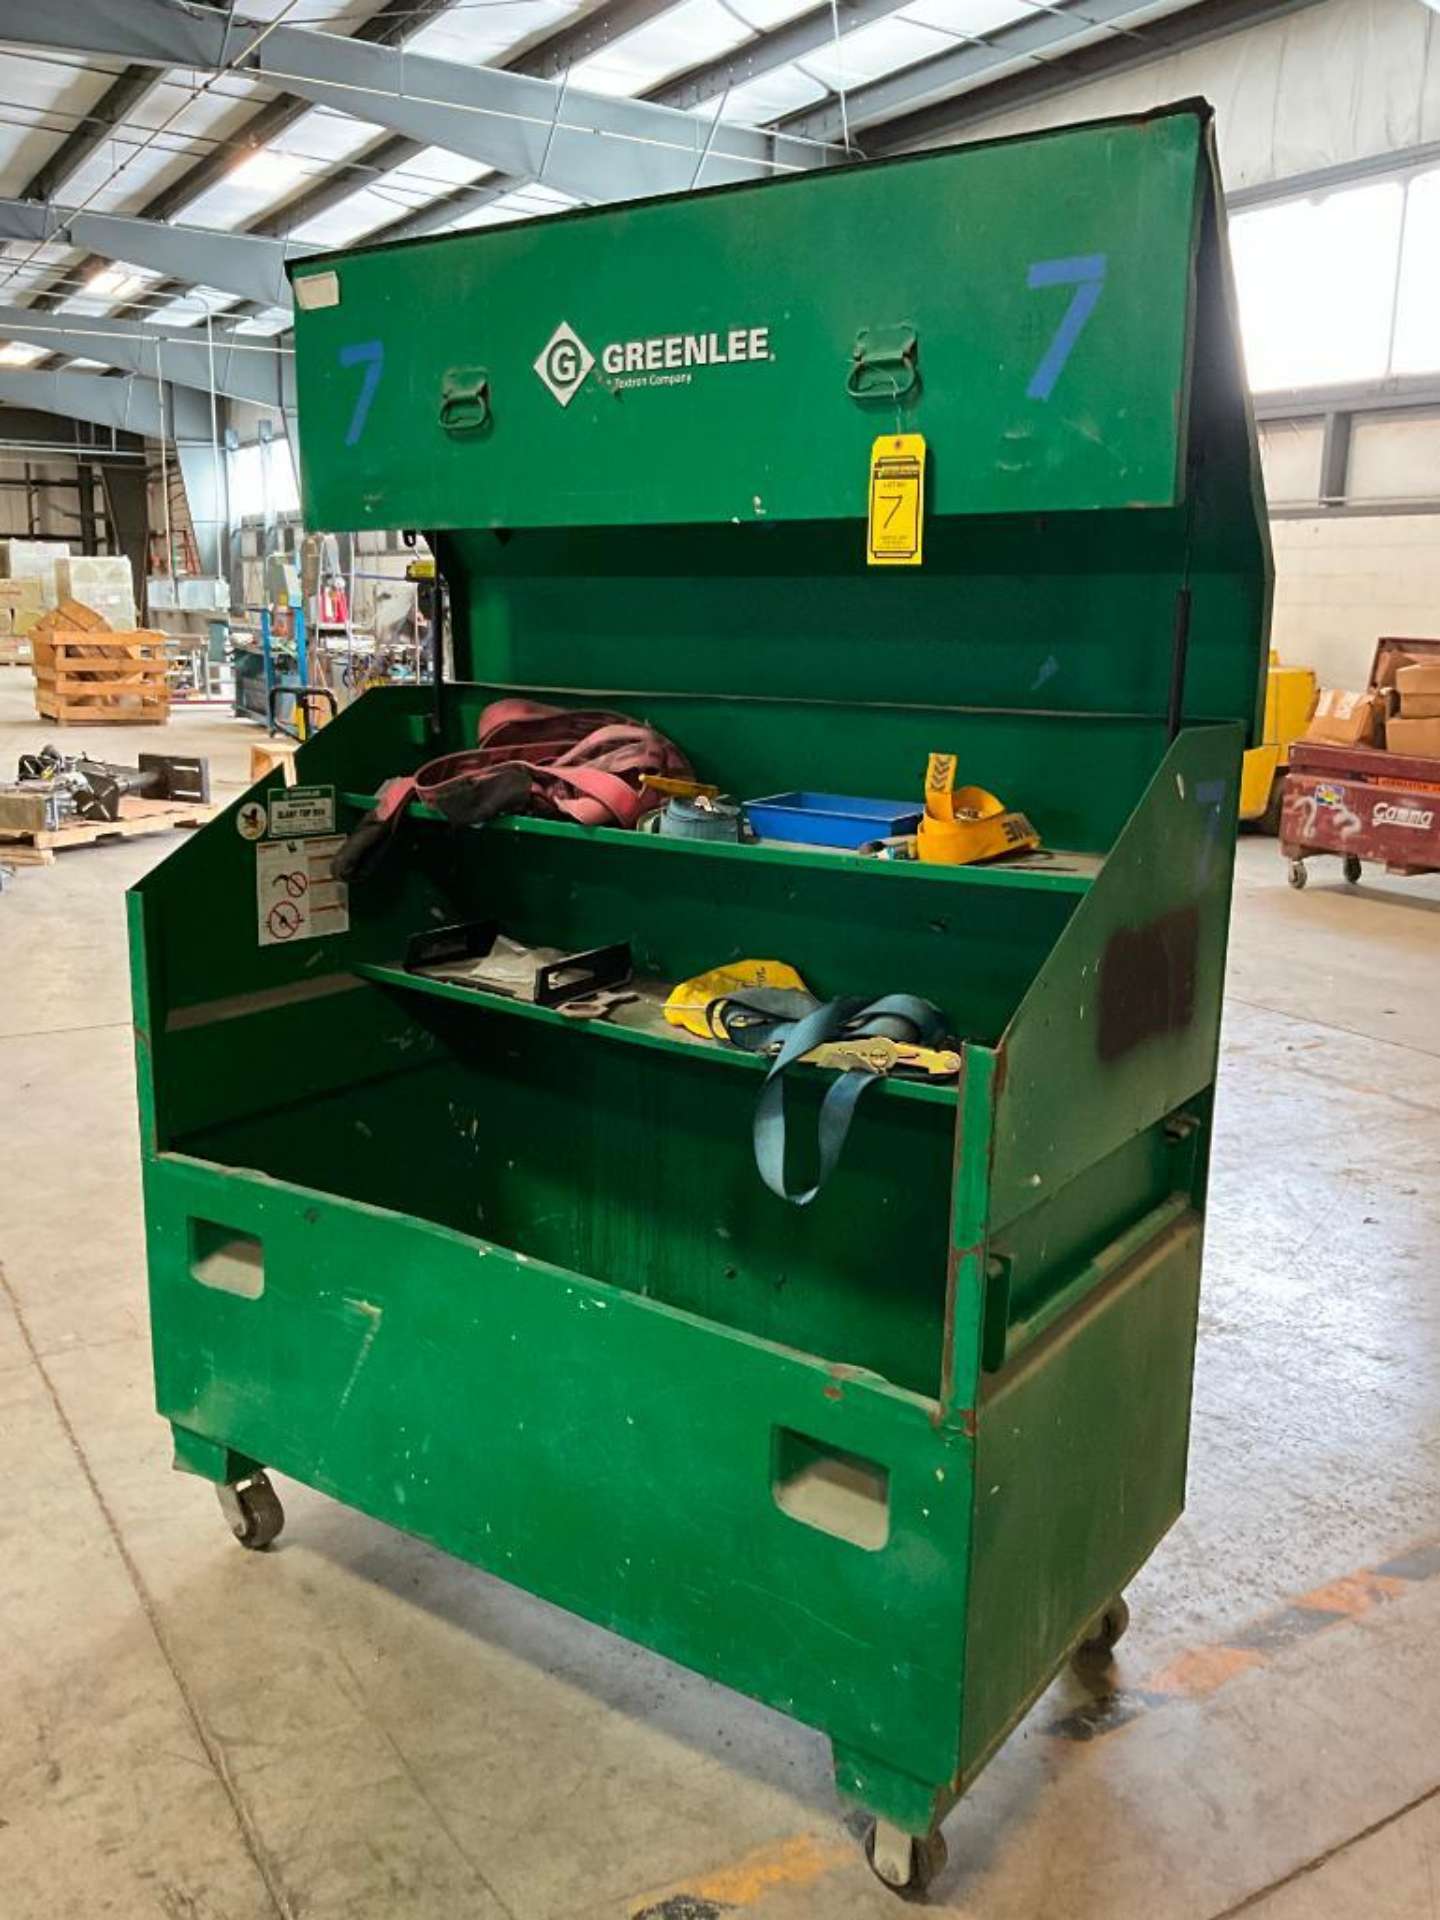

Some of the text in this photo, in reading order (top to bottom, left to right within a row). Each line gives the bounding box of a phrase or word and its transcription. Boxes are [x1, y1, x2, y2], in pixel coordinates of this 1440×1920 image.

[1027, 255, 1106, 401] 7
[551, 345, 577, 382] G
[602, 327, 769, 374] GREENLEE
[340, 340, 384, 445] 7
[649, 373, 692, 386] Company
[878, 494, 904, 529] 7
